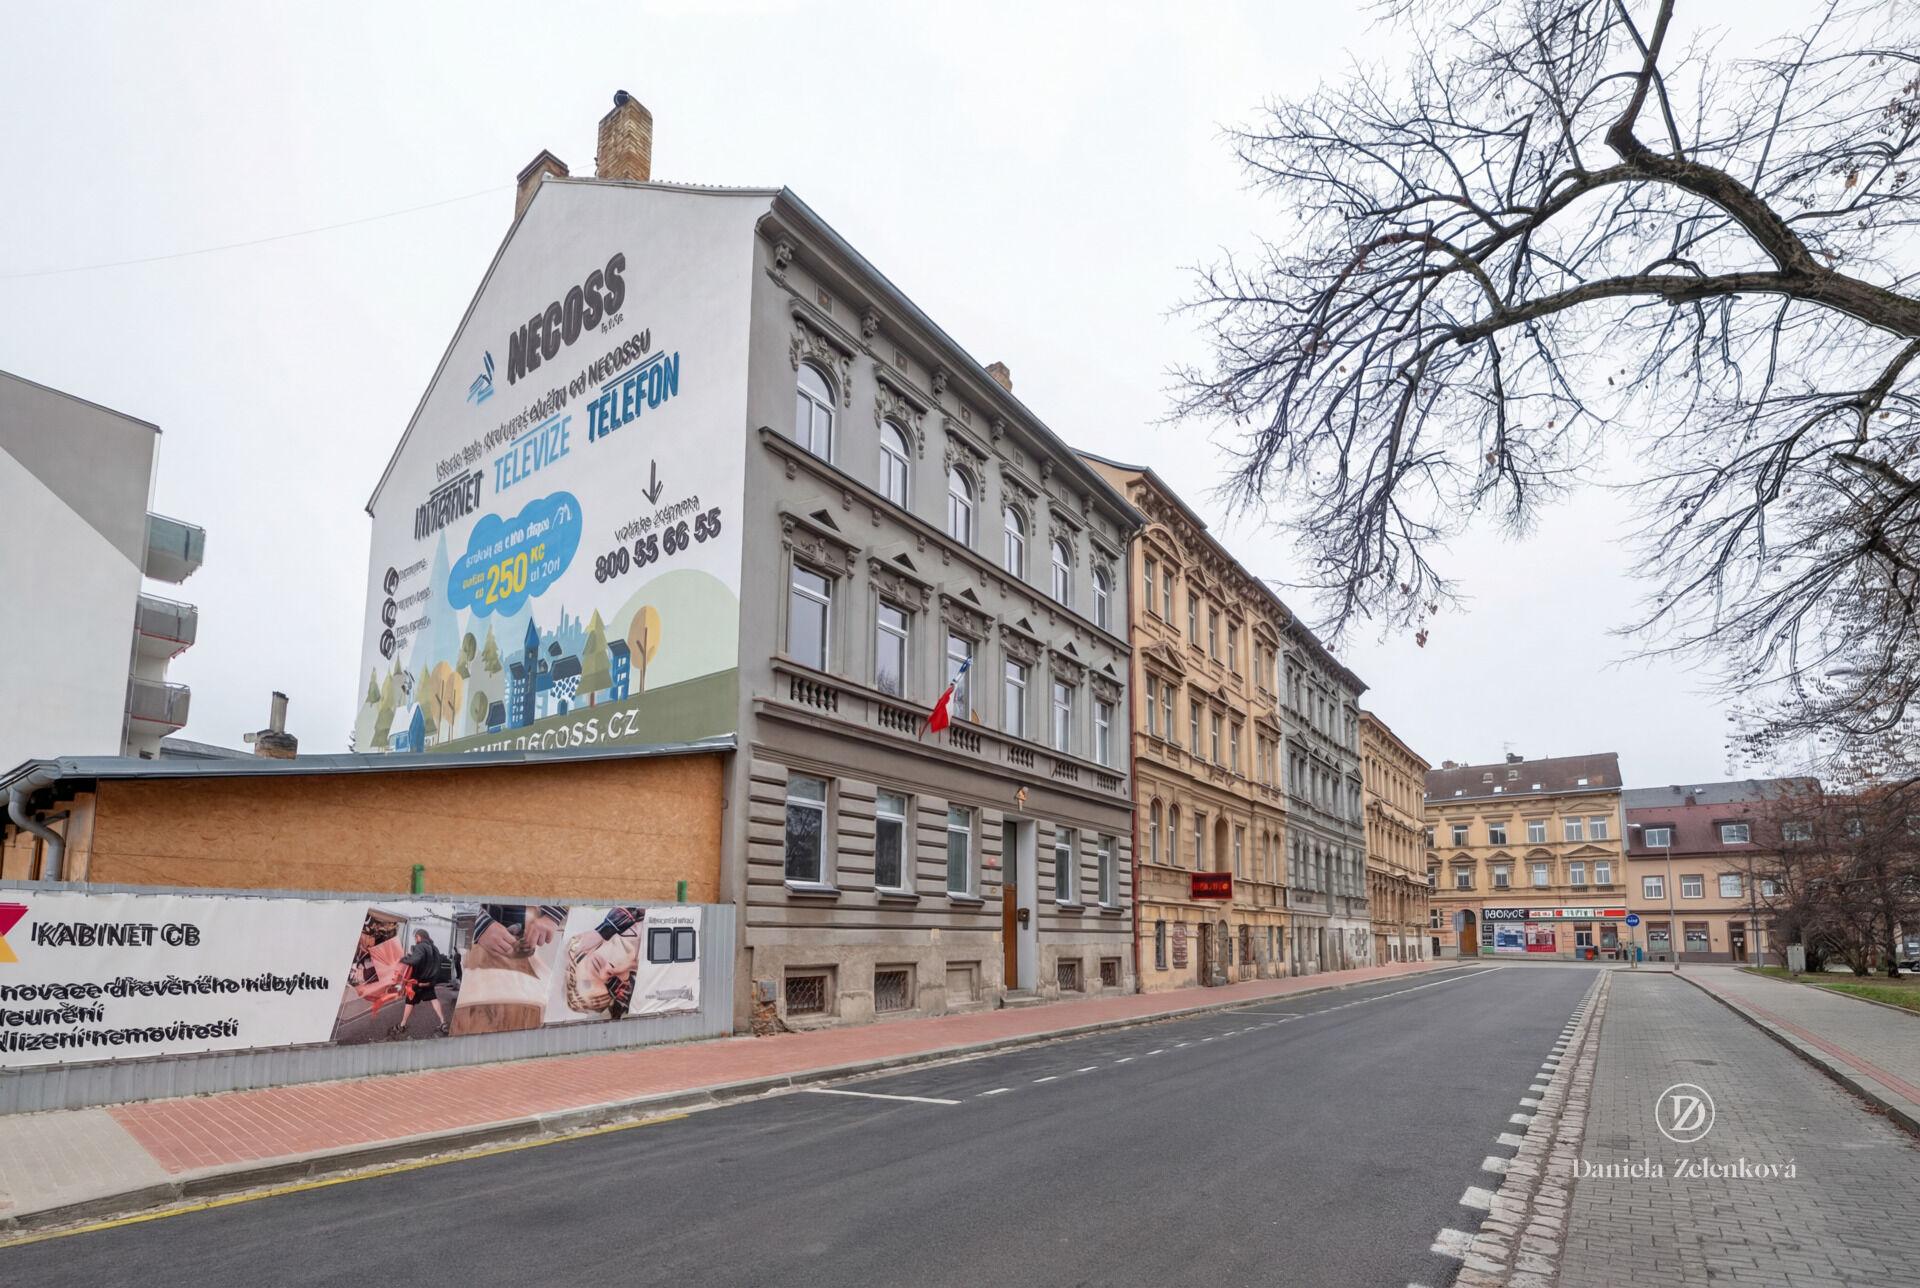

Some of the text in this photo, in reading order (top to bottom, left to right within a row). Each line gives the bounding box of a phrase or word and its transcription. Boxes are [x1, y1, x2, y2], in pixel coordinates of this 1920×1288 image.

[507, 252, 625, 386] NECOSS
[588, 327, 651, 387] NECOSSU
[587, 352, 680, 443] TELEFON
[493, 415, 572, 494] TELEVIZE
[414, 469, 484, 541] INTERNET
[485, 552, 528, 605] 250
[595, 546, 630, 584] 800
[633, 533, 659, 568] 55
[663, 520, 690, 556] 66
[694, 506, 722, 543] 55
[31, 922, 200, 946] KABINET CB
[104, 975, 240, 998] dřevěného
[241, 972, 329, 996] nábytku
